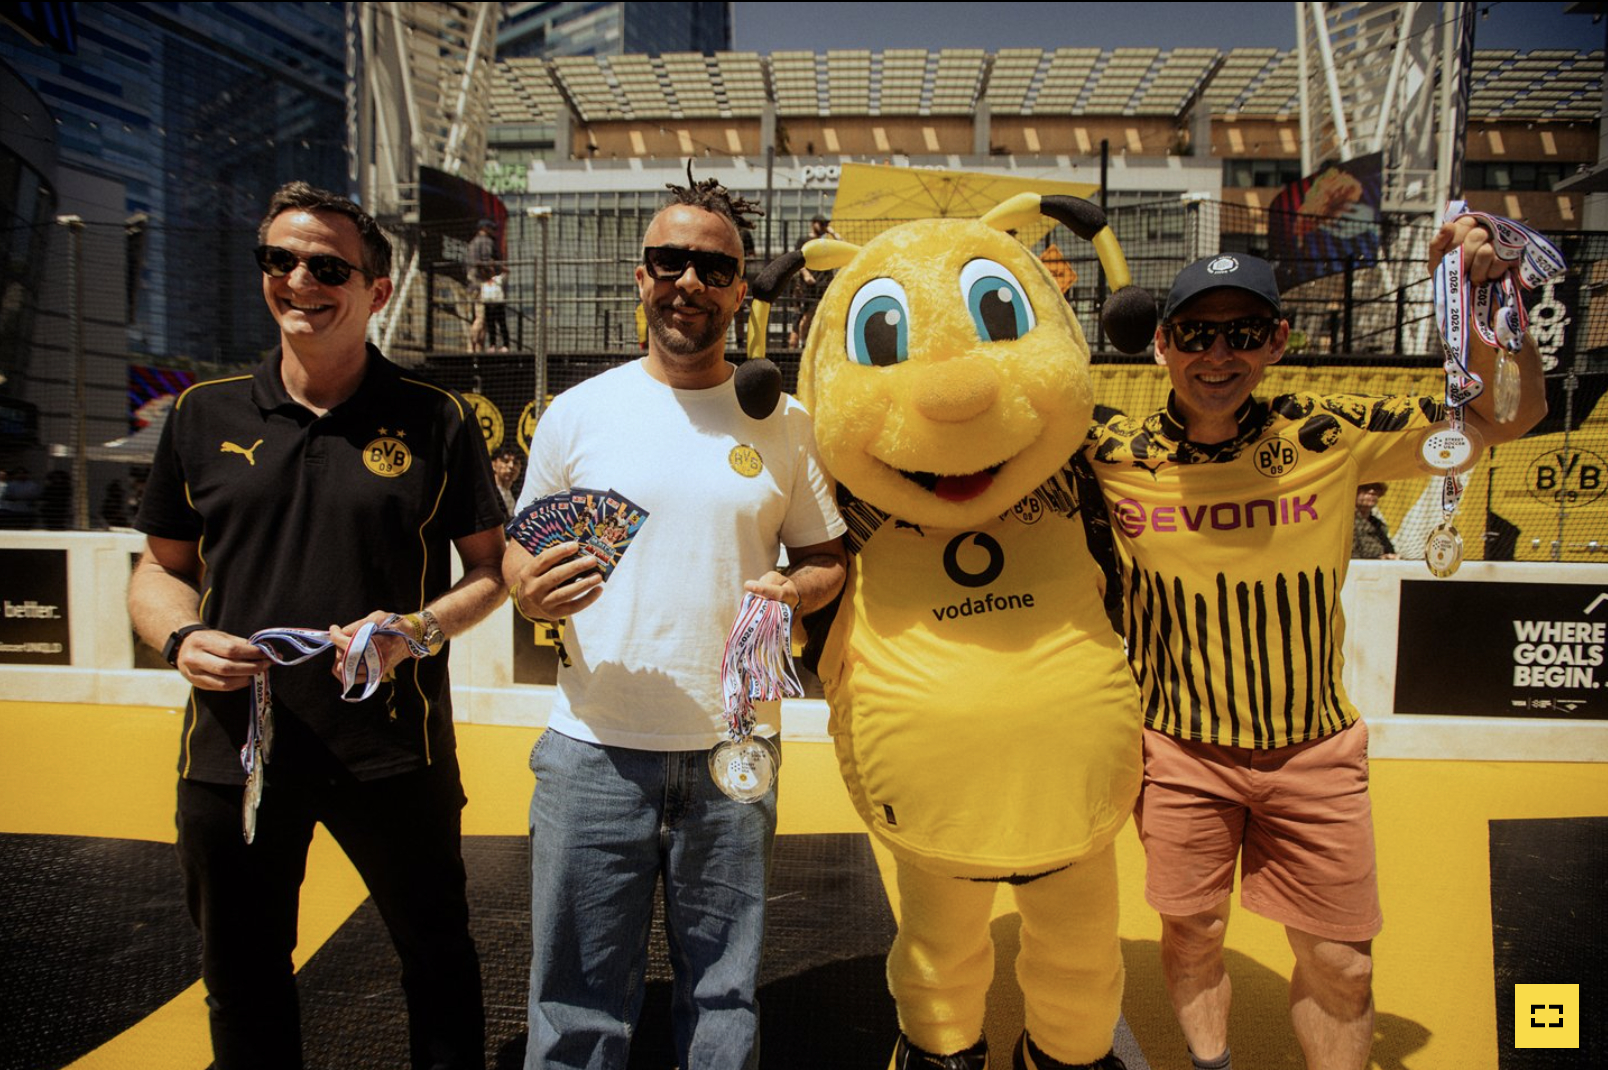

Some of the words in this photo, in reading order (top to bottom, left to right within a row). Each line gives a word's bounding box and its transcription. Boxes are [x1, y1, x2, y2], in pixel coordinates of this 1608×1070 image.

[1449, 270, 1458, 295] 2026
[1451, 308, 1460, 333] 2026
[371, 441, 405, 467] BVB
[1260, 441, 1294, 469] BVB
[379, 463, 392, 472] 09
[1271, 465, 1283, 475] 09
[1537, 454, 1600, 490] BVB
[1151, 494, 1318, 532] EVONIK
[4, 600, 62, 619] better.
[932, 593, 1035, 621] vodafone
[738, 625, 755, 648] 2026
[1513, 620, 1606, 643] WHERE
[1513, 642, 1604, 667] GOALS
[1513, 665, 1600, 689] BEGIN.
